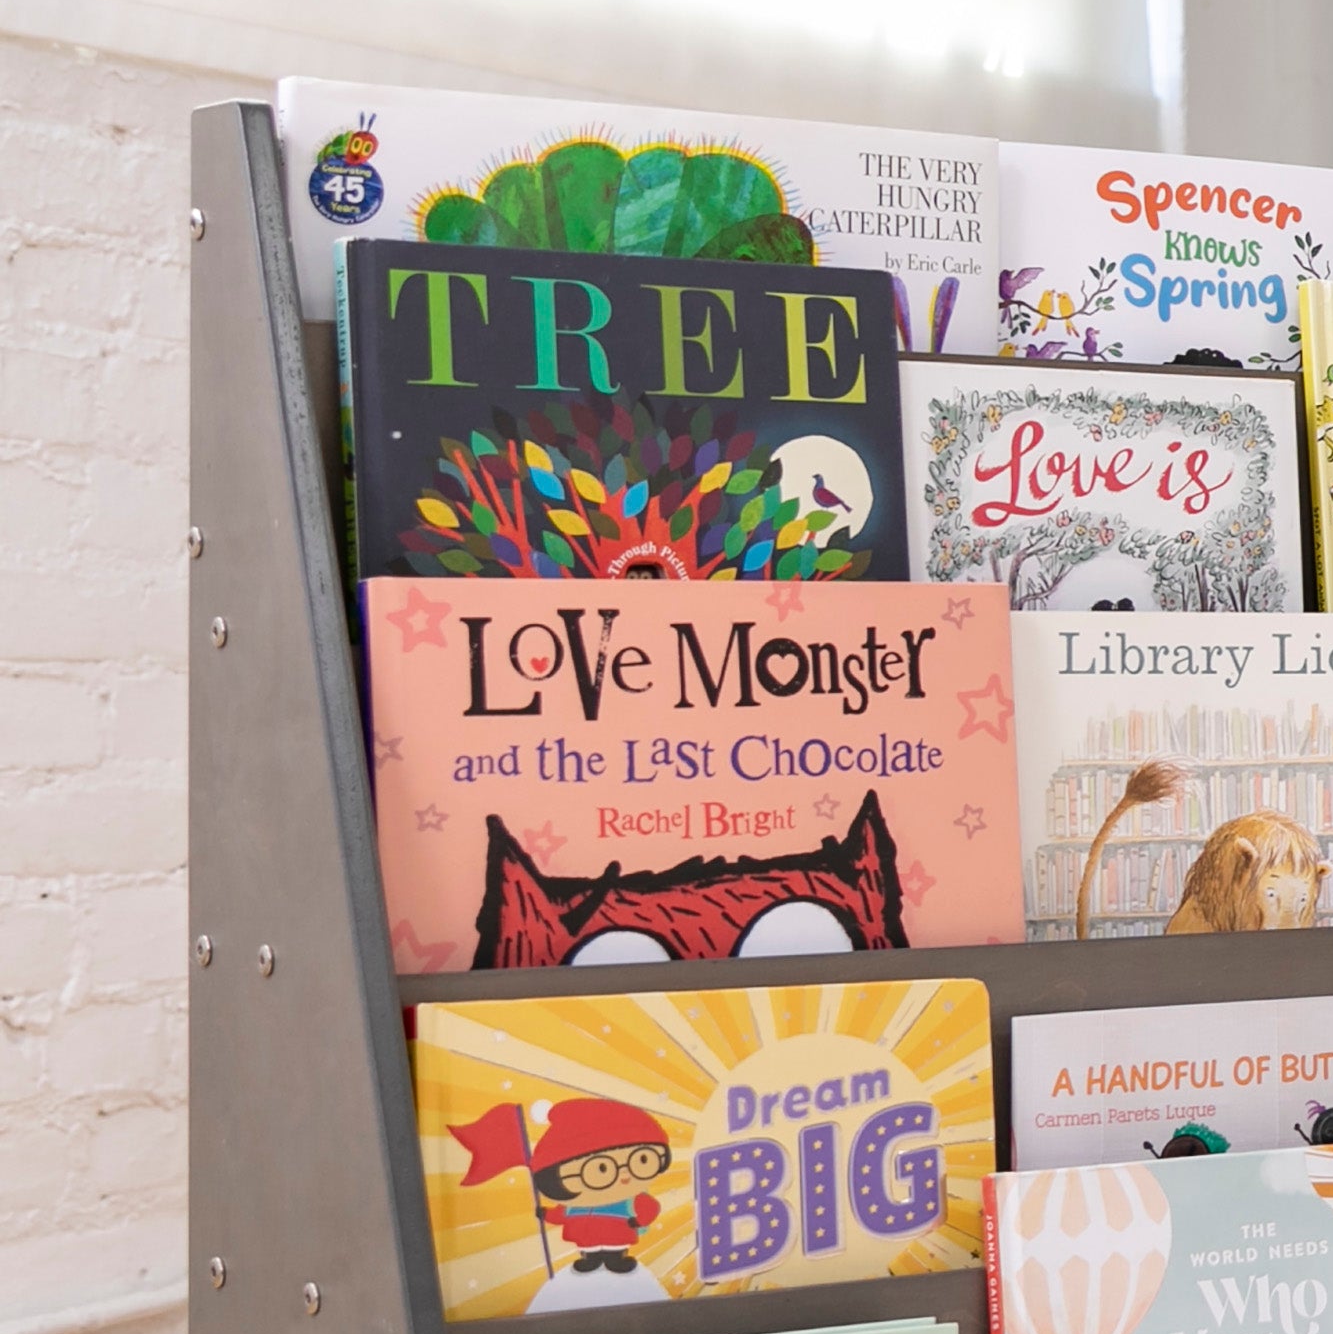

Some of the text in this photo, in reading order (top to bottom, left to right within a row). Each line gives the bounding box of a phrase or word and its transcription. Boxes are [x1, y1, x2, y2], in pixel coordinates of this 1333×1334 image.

[324, 174, 365, 204] 45
[859, 152, 983, 185] THE VERY
[330, 202, 361, 214] Years
[877, 183, 983, 215] HUNGRY
[1097, 170, 1302, 231] Spencer
[809, 208, 982, 244] CATERPILLAR
[885, 252, 982, 275] by Eric Carle
[1120, 253, 1288, 323] Spring
[389, 269, 868, 404] TREE
[971, 420, 1234, 527] Love is
[670, 621, 936, 714] Monster
[1058, 631, 1254, 688] Library
[454, 744, 521, 782] and
[535, 738, 607, 783] the
[597, 802, 796, 840] Rachel Bright
[1051, 1068, 1075, 1098] A
[1086, 1059, 1224, 1096] HANDFUL
[1233, 1054, 1271, 1086] OF
[726, 1068, 890, 1134] Dream
[1035, 1102, 1216, 1129] Carmen Parets Luque
[694, 1102, 948, 1283] BIG
[1240, 1222, 1277, 1239] THE
[986, 1215, 999, 1331] JOANNA GAINES
[1190, 1240, 1329, 1267] WORLD NEEDS
